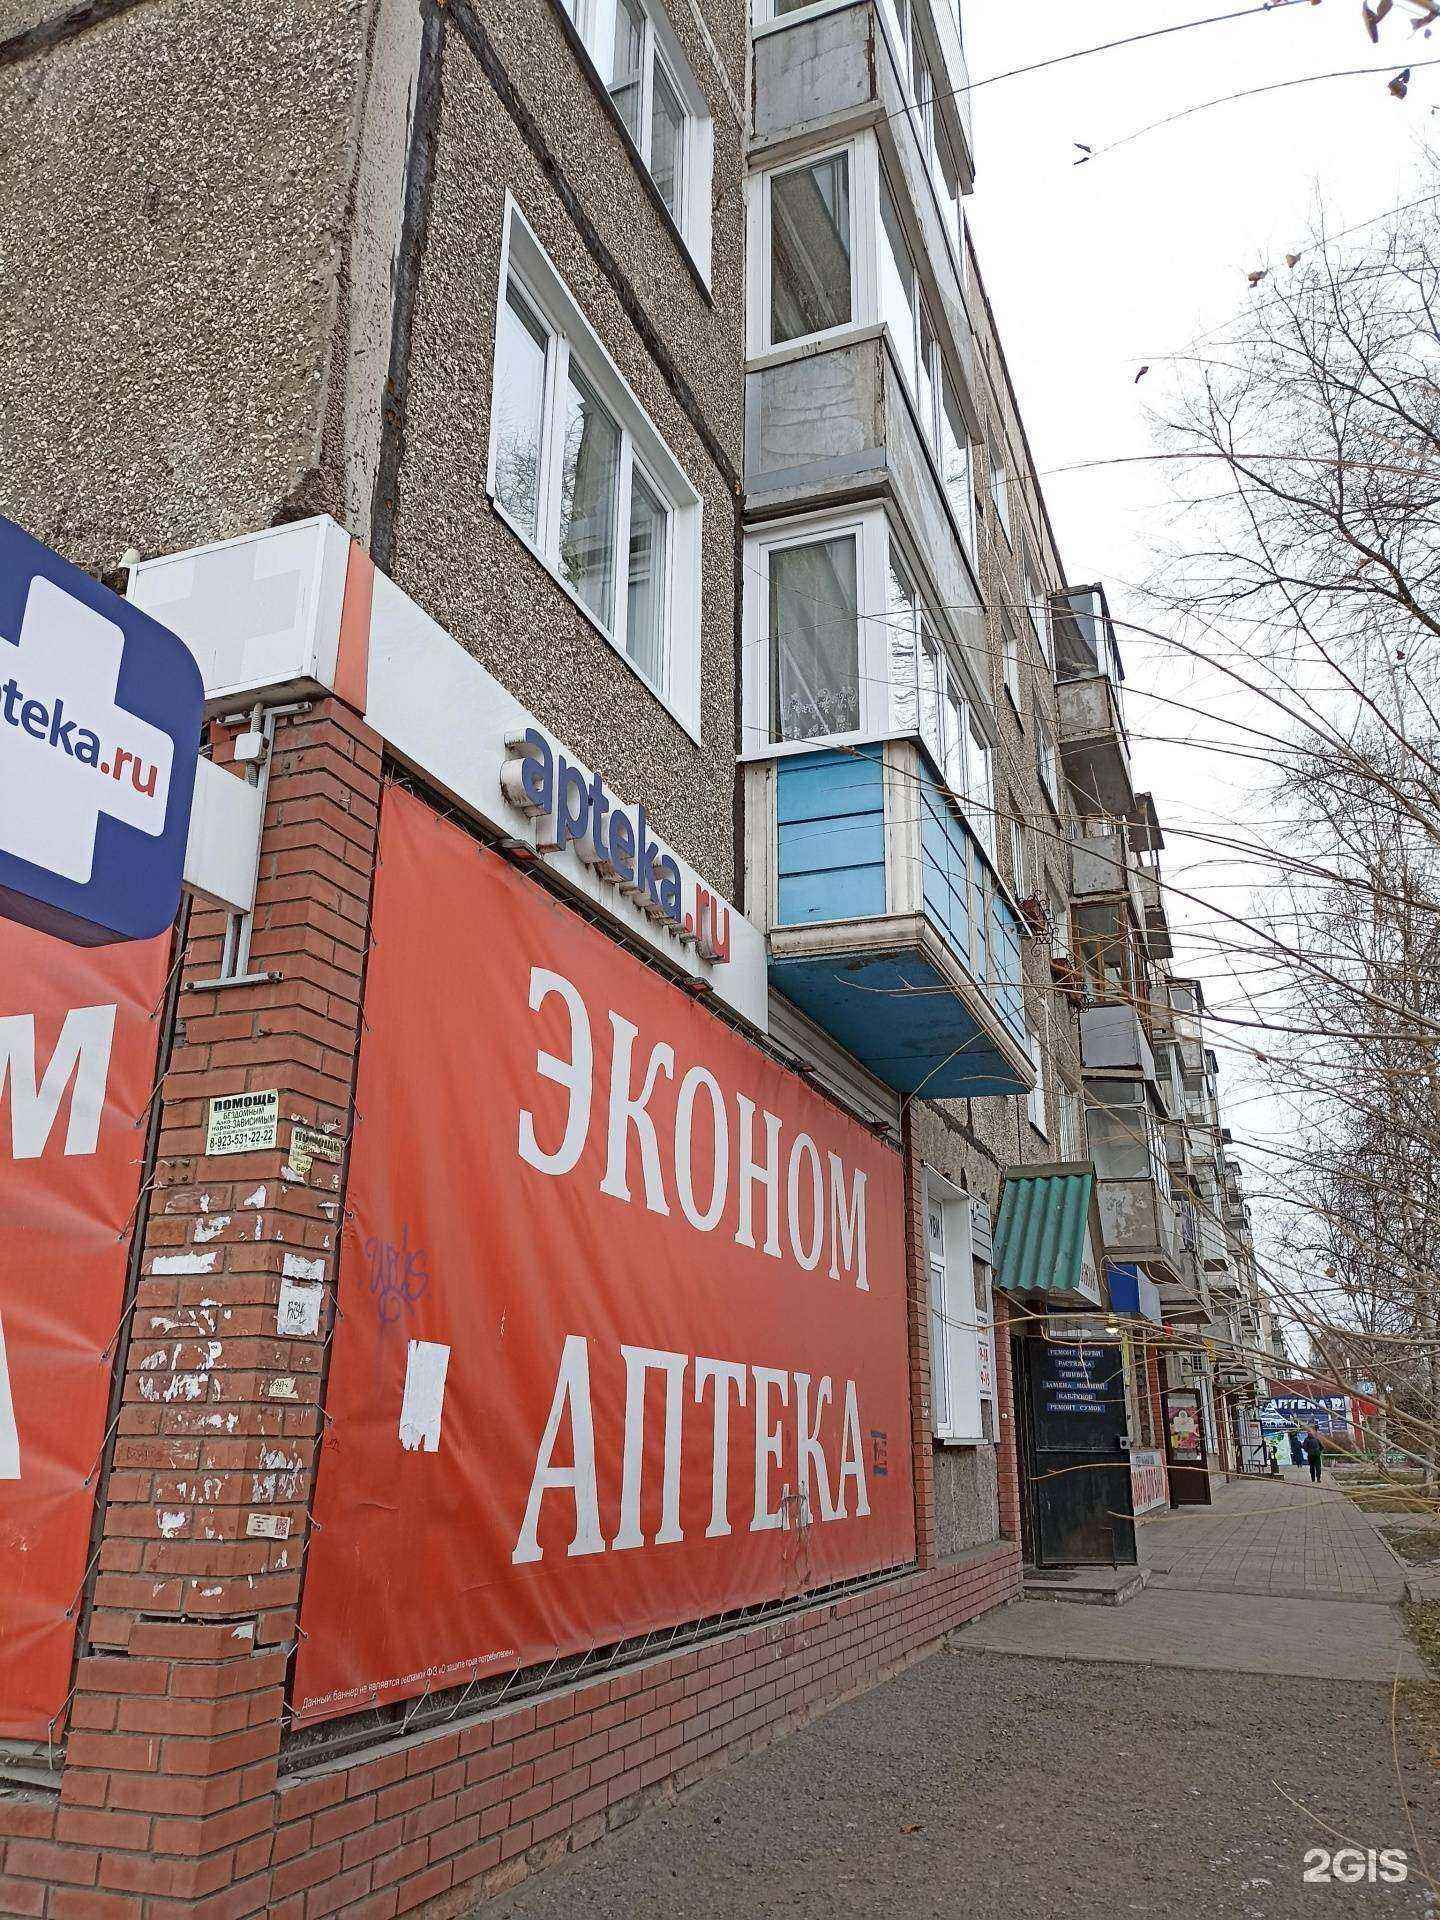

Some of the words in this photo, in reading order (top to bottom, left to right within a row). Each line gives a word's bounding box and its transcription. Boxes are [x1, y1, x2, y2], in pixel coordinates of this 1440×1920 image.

[0, 679, 157, 797] teka.ru
[505, 728, 730, 963] apteka.ru
[209, 1129, 274, 1149] 8-923-531-22-22
[213, 1093, 276, 1111] ПОМОЩЬ
[518, 966, 871, 1293] ЭКОНОМ
[1049, 1403, 1076, 1412] РЕМОНТ
[1079, 1404, 1102, 1412] СУМОК
[511, 1334, 871, 1565] АПТЕКА
[302, 1693, 333, 1711] Данный
[333, 1688, 358, 1701] баннер
[368, 1678, 400, 1692] является
[427, 1665, 438, 1676] ФЗ
